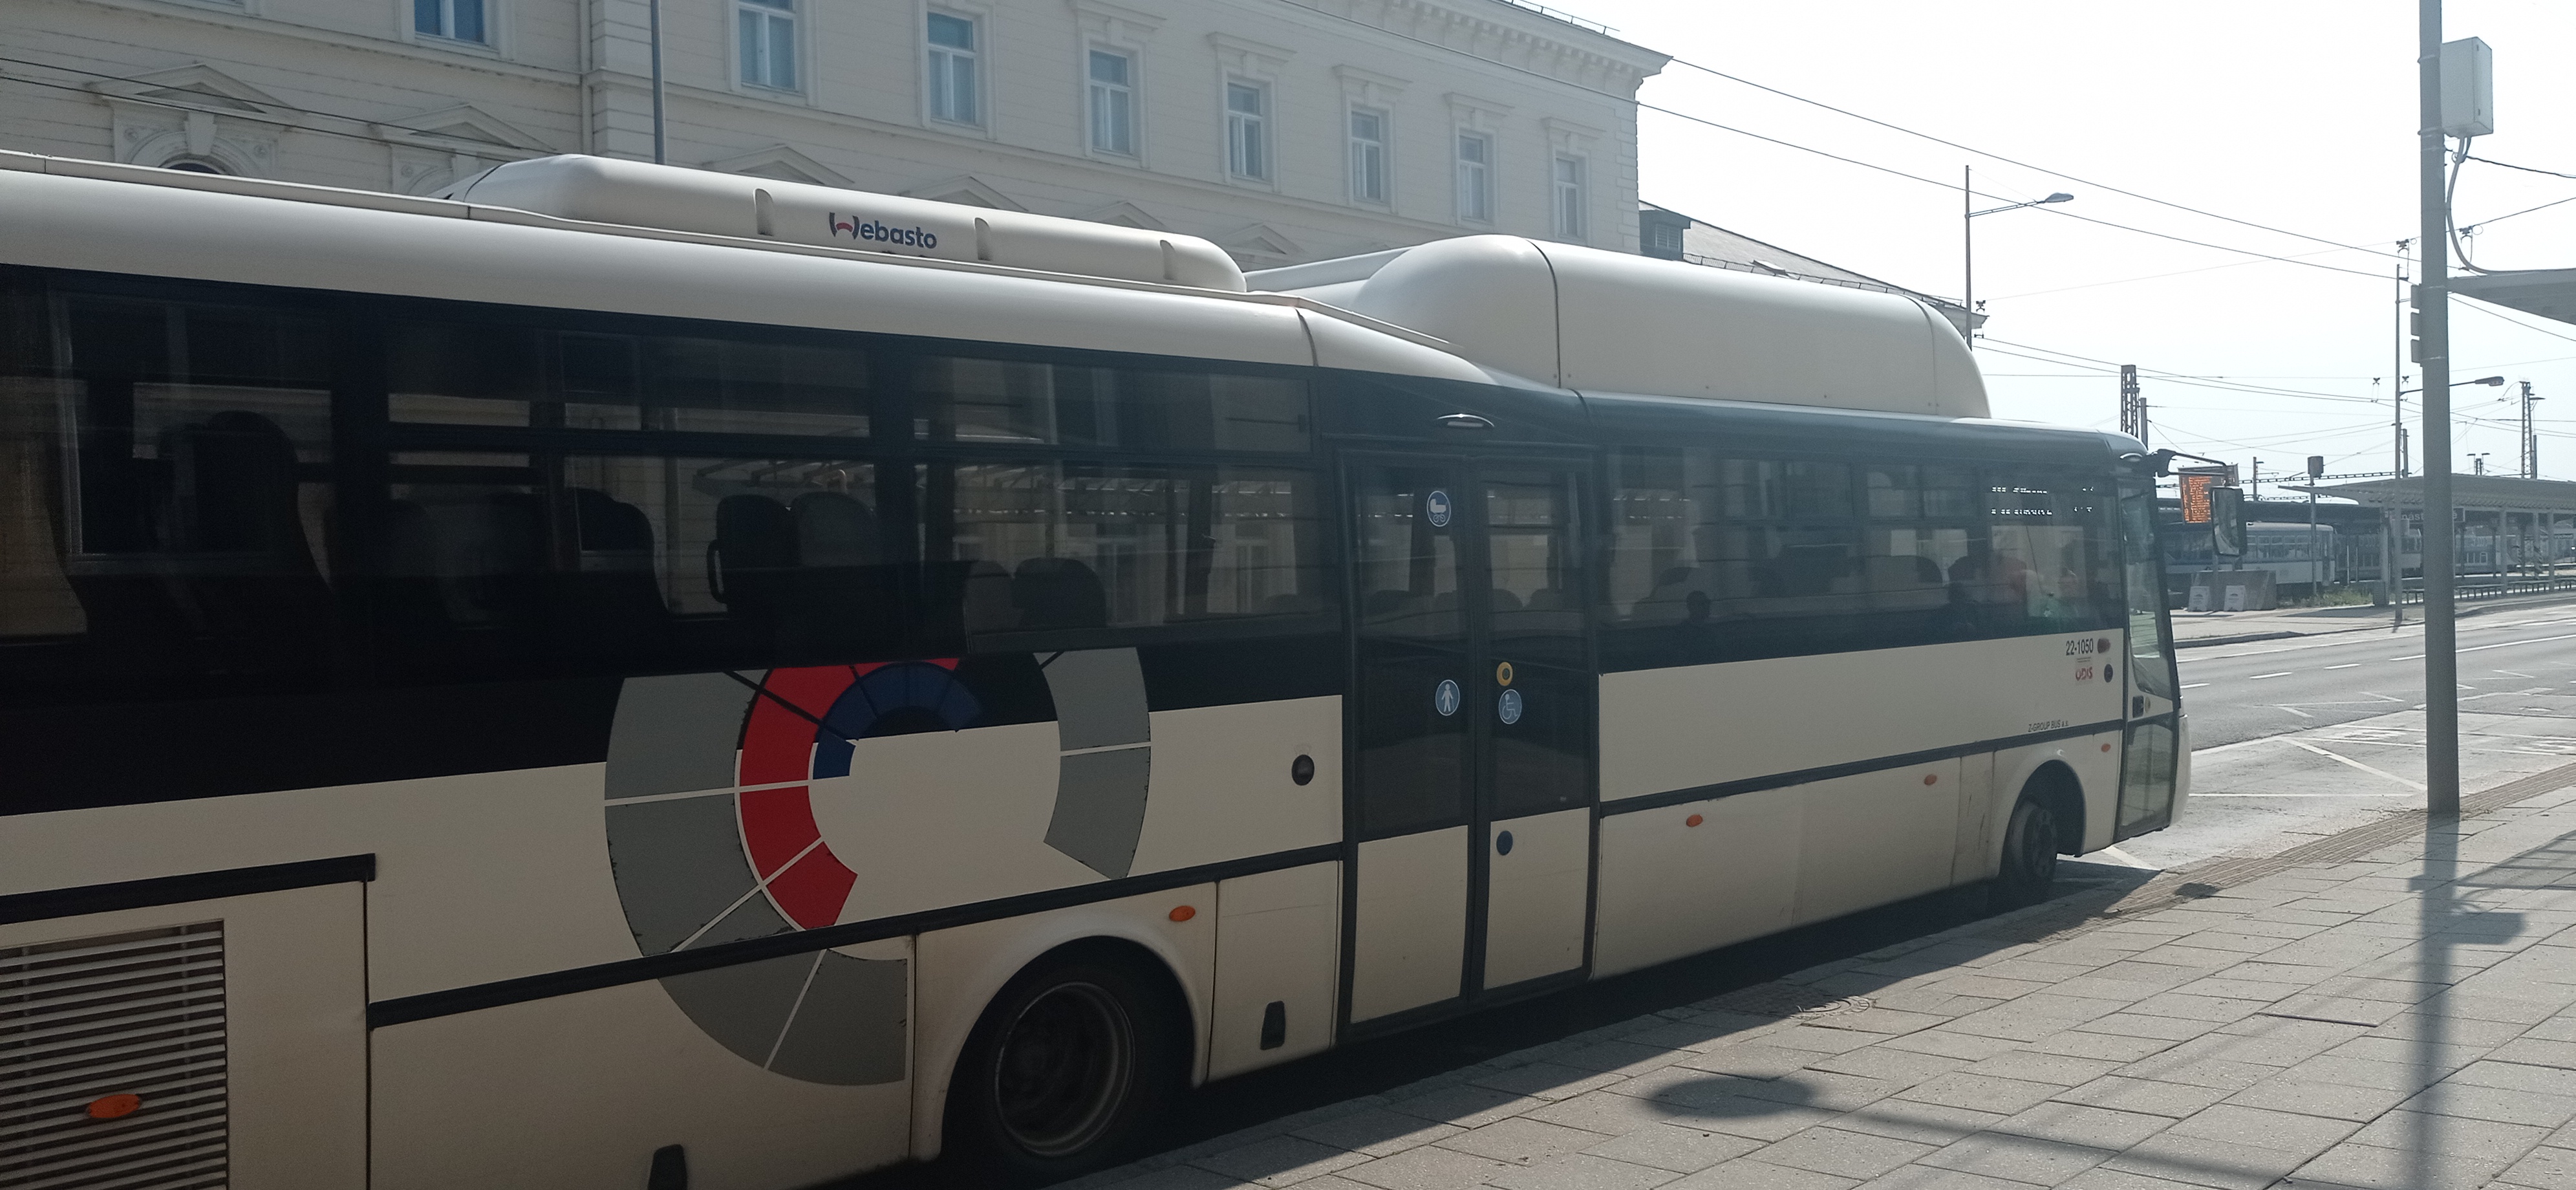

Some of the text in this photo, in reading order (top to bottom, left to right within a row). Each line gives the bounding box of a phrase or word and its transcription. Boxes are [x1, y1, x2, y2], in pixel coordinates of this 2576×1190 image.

[829, 212, 938, 249] Webasto
[2066, 638, 2094, 656] 22-1050
[2051, 719, 2061, 729] BUS
